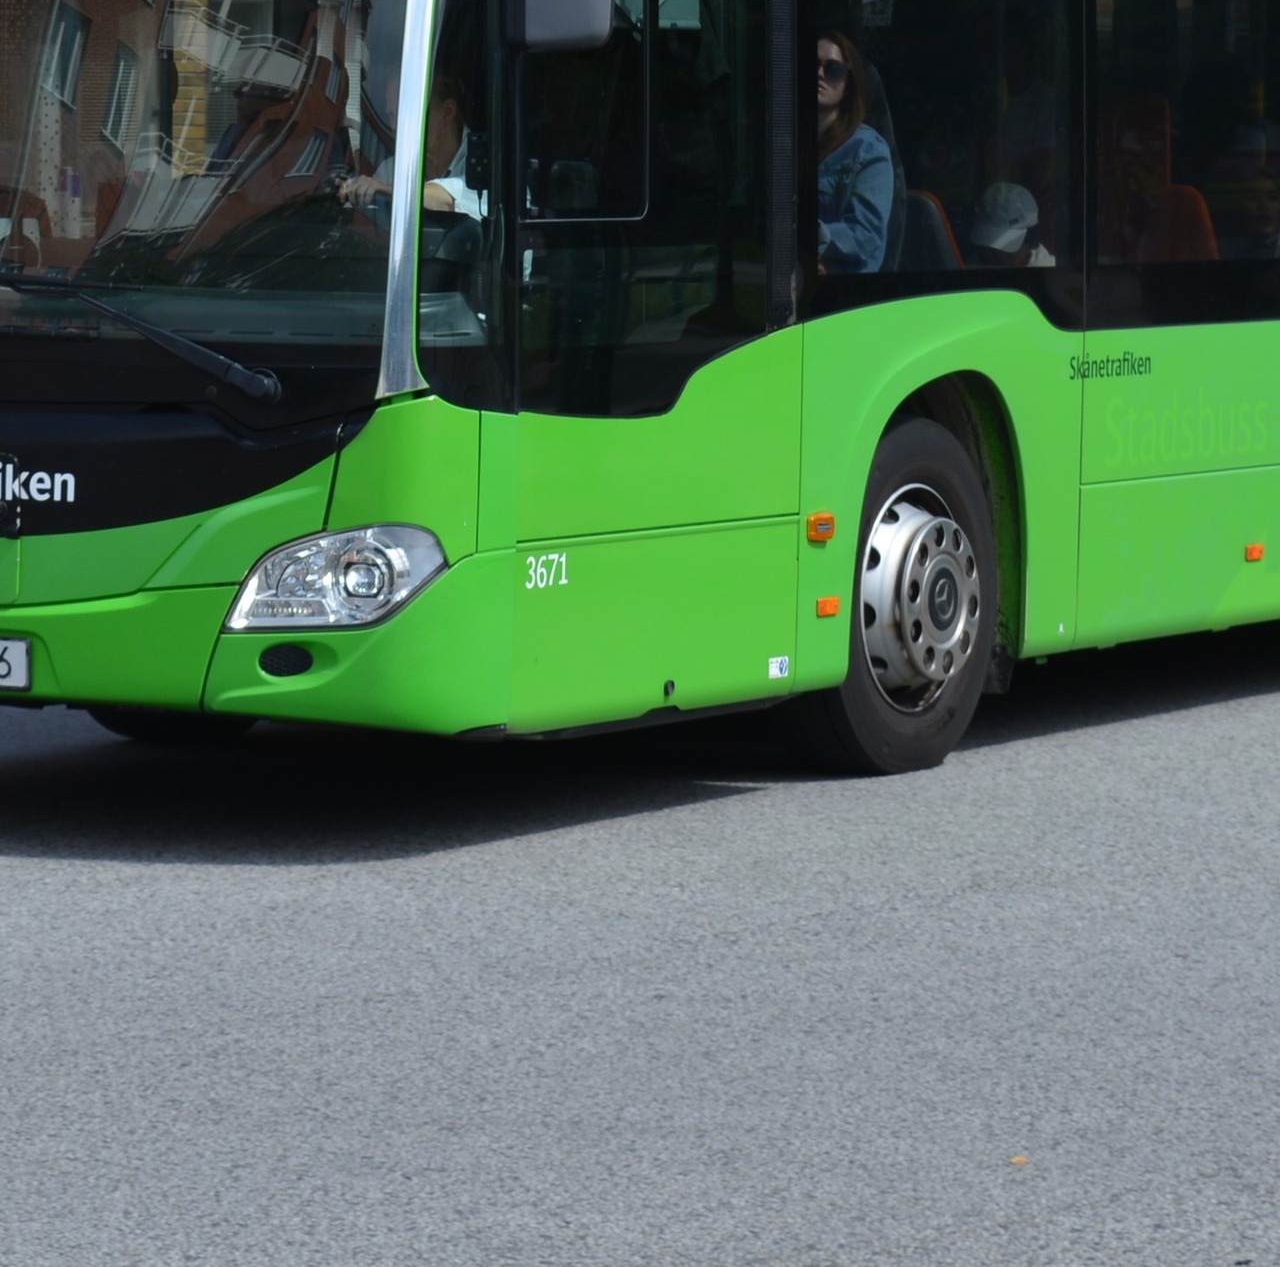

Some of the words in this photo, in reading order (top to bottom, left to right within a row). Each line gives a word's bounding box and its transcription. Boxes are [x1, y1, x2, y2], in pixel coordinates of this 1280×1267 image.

[1069, 350, 1152, 381] Skånetrafiken
[1104, 385, 1269, 468] Stadsbuss
[525, 552, 569, 590] 3671
